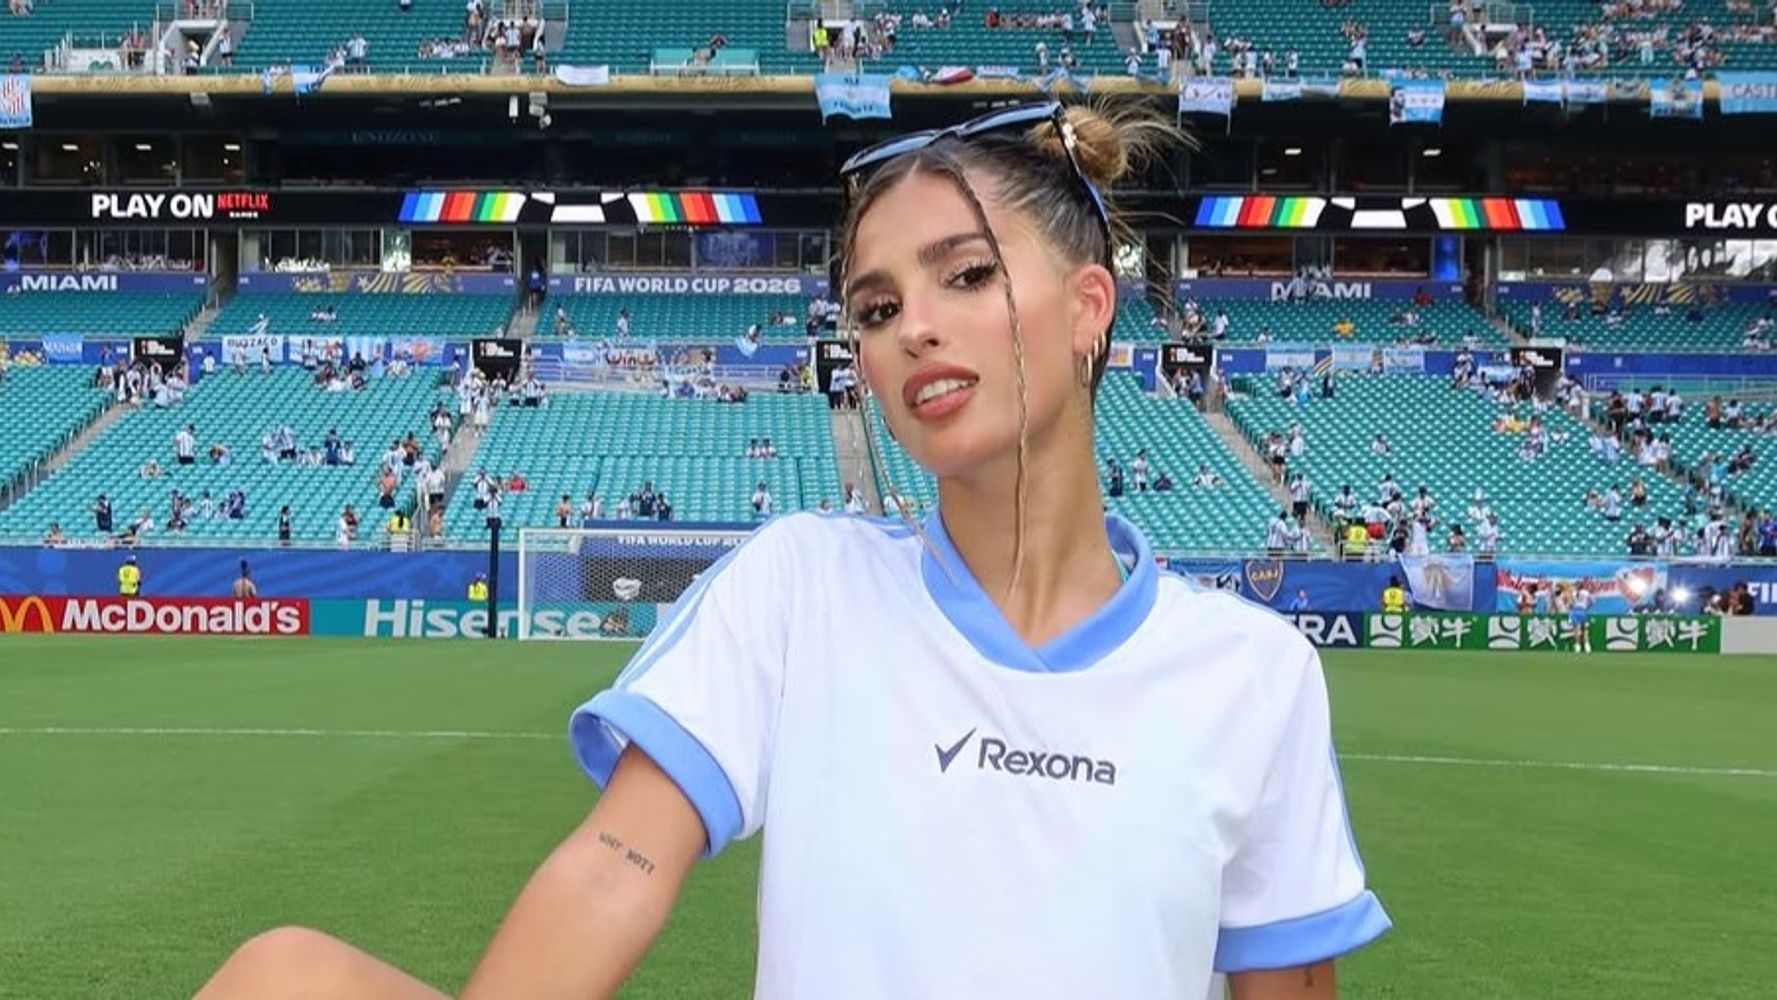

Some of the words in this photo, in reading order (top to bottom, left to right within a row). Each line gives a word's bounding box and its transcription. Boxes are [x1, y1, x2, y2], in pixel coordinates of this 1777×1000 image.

[92, 194, 165, 218] PLAY
[170, 194, 213, 218] ON
[217, 193, 268, 209] NETFLIX
[1686, 203, 1764, 228] PLAY
[22, 275, 117, 291] MIAMI
[574, 278, 616, 293] FIFA
[618, 278, 688, 293] WORLD
[691, 278, 730, 293] CUP
[732, 278, 801, 293] 2026
[1271, 282, 1371, 300] MAMI
[62, 599, 300, 633] McDonald's
[364, 599, 602, 637] Hisense
[1283, 614, 1357, 645] RA
[1409, 615, 1472, 648] 蒙牛
[1645, 619, 1709, 650] 蒙牛
[978, 737, 1116, 786] Rexona
